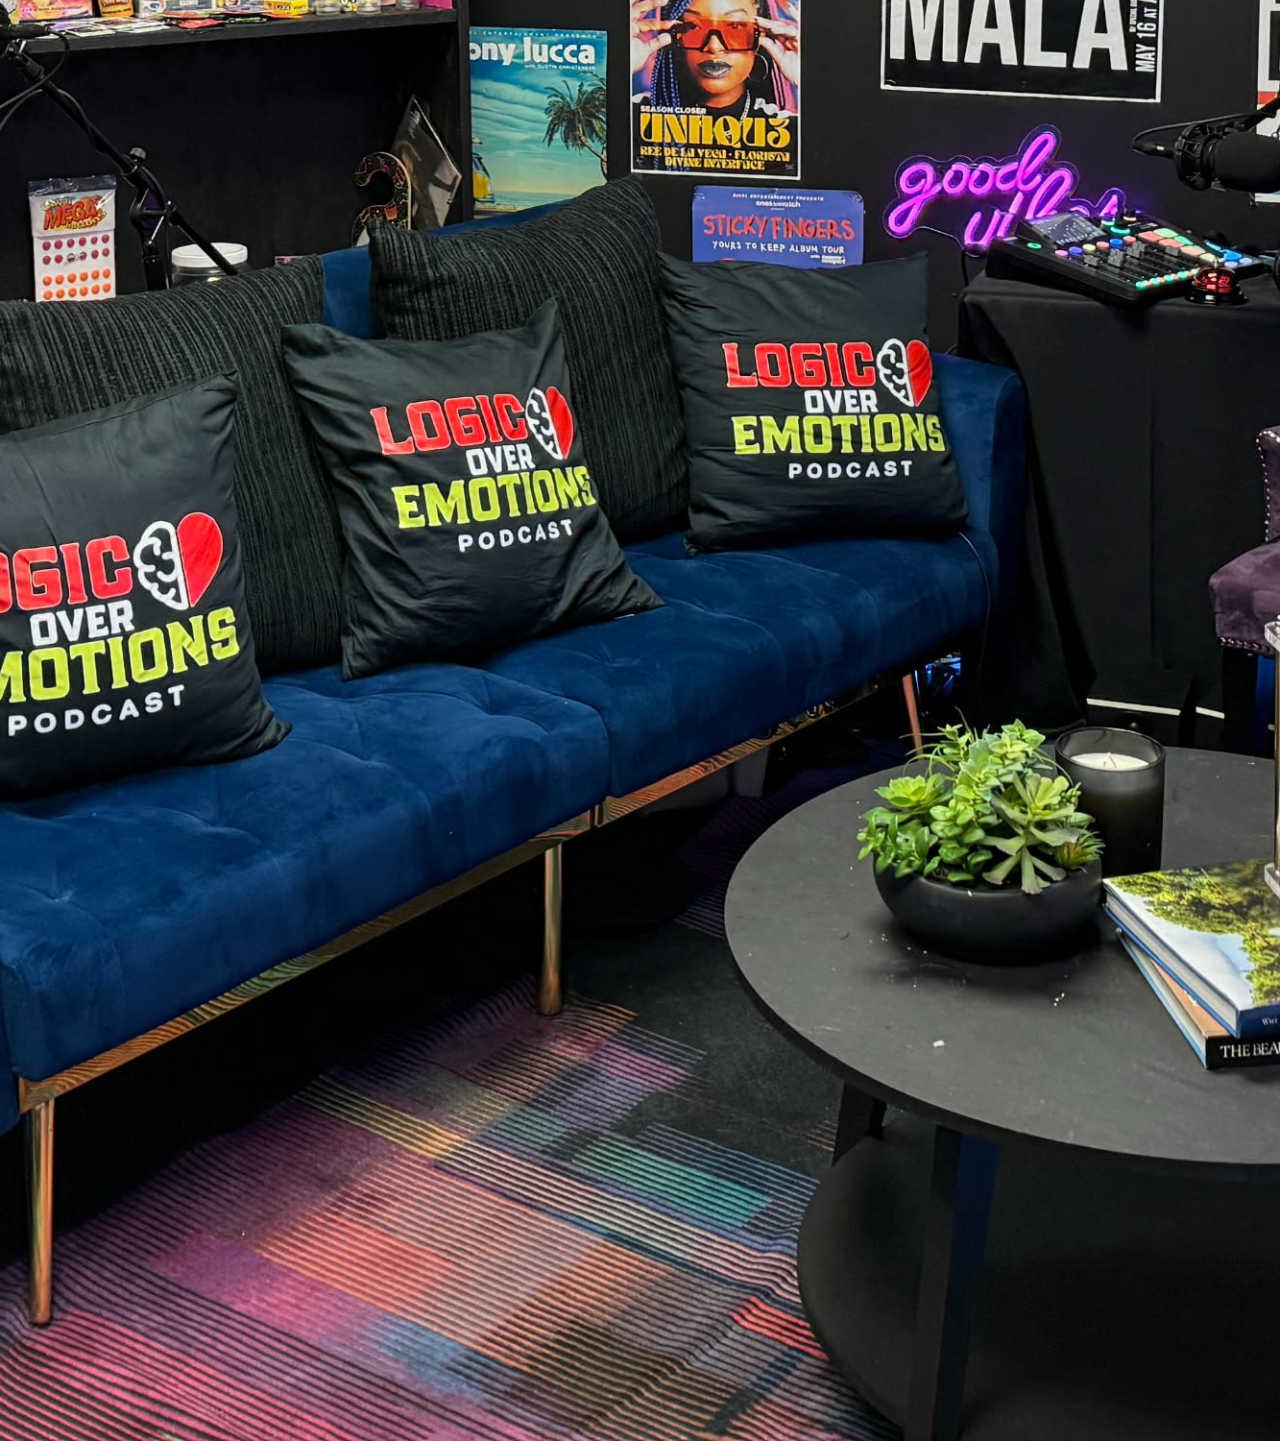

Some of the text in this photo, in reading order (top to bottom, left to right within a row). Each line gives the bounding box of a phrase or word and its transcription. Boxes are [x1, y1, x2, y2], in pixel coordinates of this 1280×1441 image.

[1143, 6, 1158, 19] AT
[1136, 21, 1157, 39] 16
[523, 36, 596, 64] lucca
[1135, 43, 1156, 73] MAY
[640, 105, 707, 115] SEASON CLOSER
[640, 146, 662, 157] REE
[664, 147, 679, 157] DE
[665, 157, 702, 169] DIVINE
[888, 131, 1057, 234] good
[703, 213, 857, 241] STICKY FINGERS
[712, 240, 845, 254] YOURS TO KEEP ALBUM TOUR
[722, 341, 877, 389] LOGIC
[804, 388, 880, 415] OVER
[370, 393, 526, 457] LOGIC
[730, 413, 946, 456] EMOTIONS
[465, 442, 536, 477] OVER
[787, 460, 913, 481] PODCAST
[392, 464, 599, 531] EMOTIONS
[457, 518, 575, 553] PODCAST
[30, 599, 136, 647] OVER
[8, 684, 185, 737] PODCAST
[1220, 1042, 1251, 1059] THE
